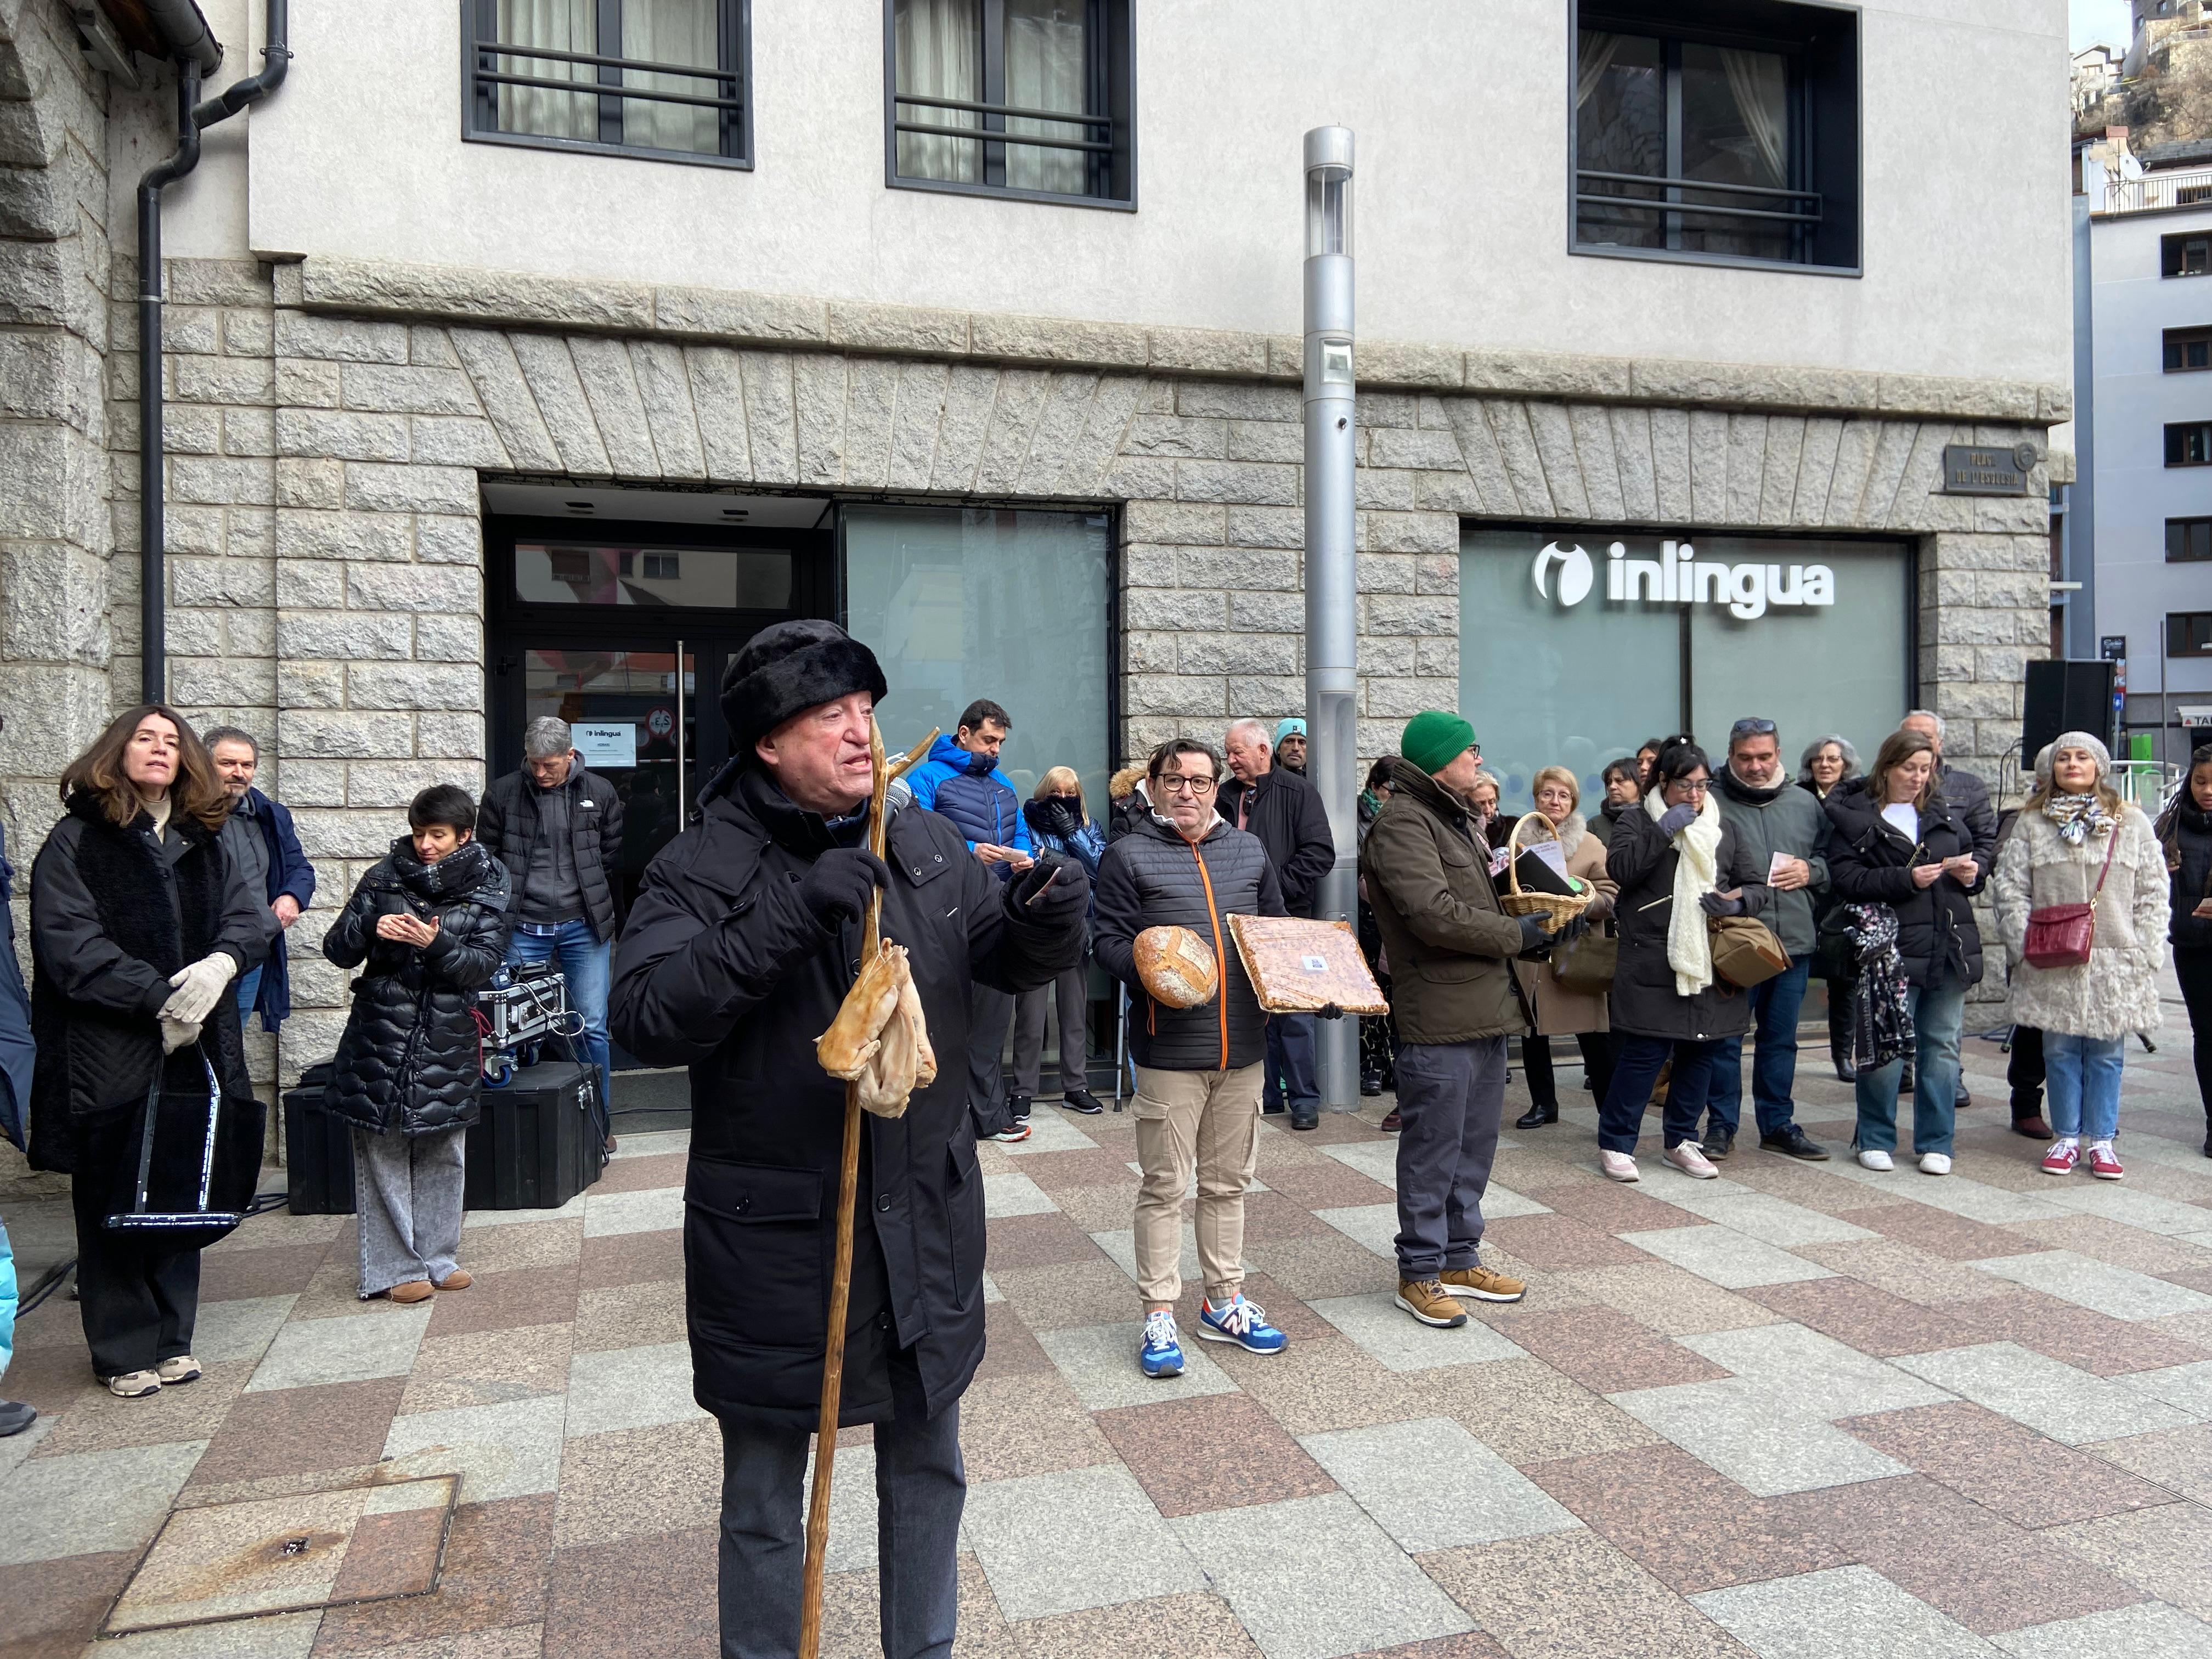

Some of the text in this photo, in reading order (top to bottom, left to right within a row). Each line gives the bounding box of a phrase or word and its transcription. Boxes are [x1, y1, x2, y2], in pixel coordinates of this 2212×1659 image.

[1956, 469, 1967, 483] DE
[1606, 540, 1834, 620] inlingua
[2194, 716, 2212, 725] TA
[594, 730, 621, 738] inlingua
